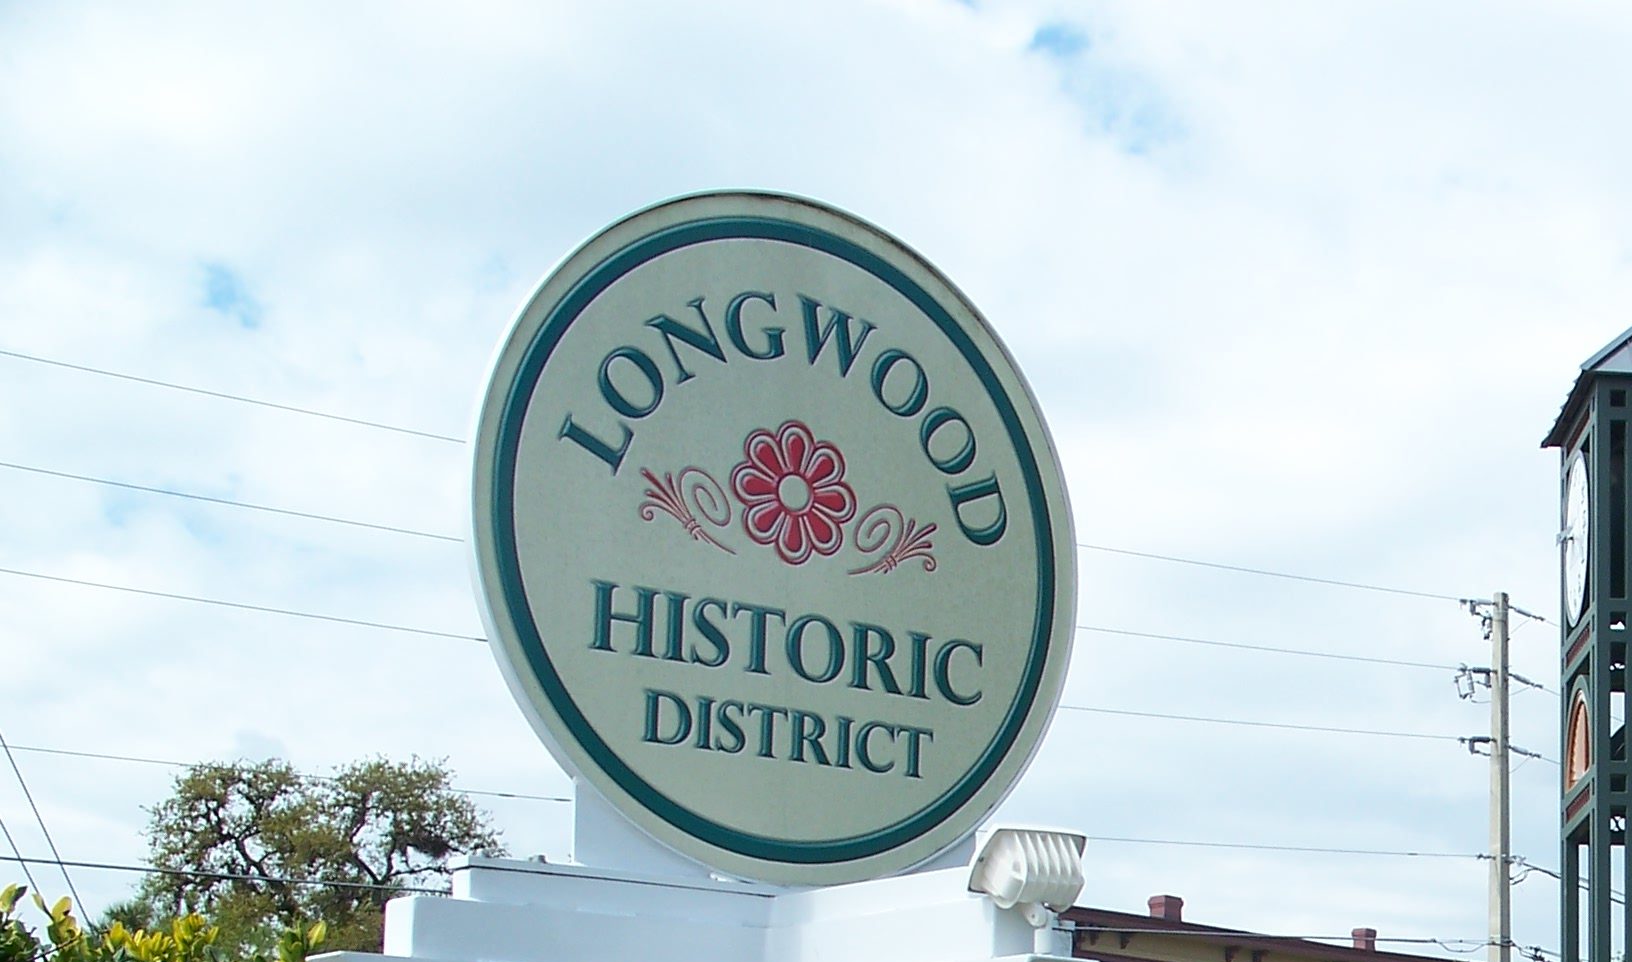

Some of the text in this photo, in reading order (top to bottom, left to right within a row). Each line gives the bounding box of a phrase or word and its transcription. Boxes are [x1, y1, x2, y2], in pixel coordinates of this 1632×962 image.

[559, 291, 1009, 547] LONGWOOD
[587, 579, 984, 706] HISTORIC
[640, 687, 934, 780] DISTRICT
